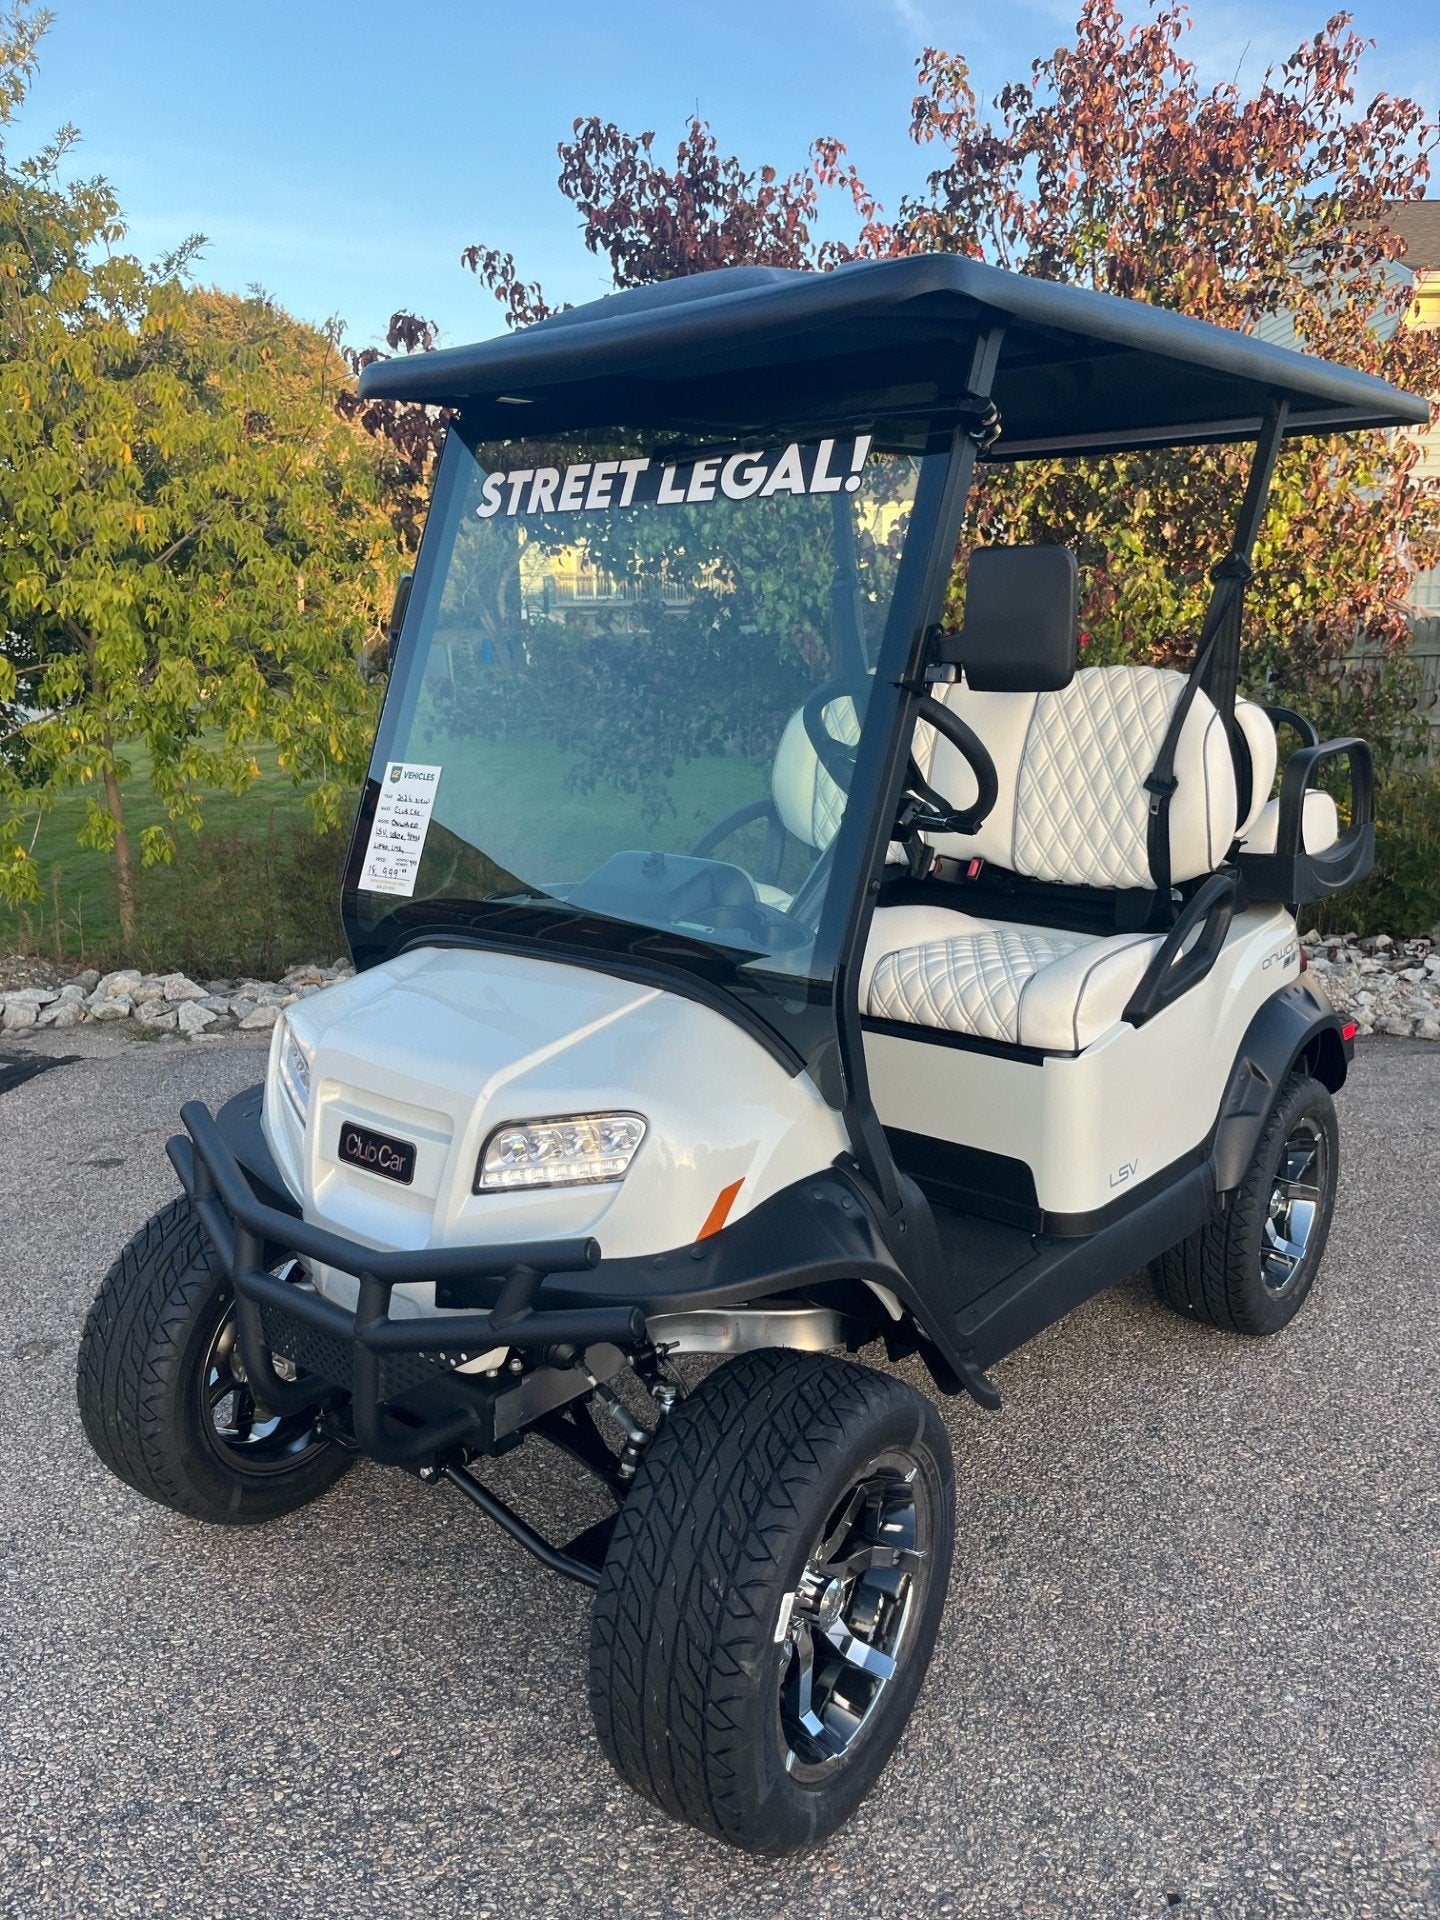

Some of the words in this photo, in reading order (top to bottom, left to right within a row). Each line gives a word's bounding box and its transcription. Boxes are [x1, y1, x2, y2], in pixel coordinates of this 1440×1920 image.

[475, 457, 650, 519] STREET
[656, 434, 872, 506] LEGAL!
[403, 771, 435, 782] VEHICLES
[346, 1132, 377, 1163] Club
[378, 1144, 407, 1172] Car
[1109, 1157, 1139, 1188] LSV
